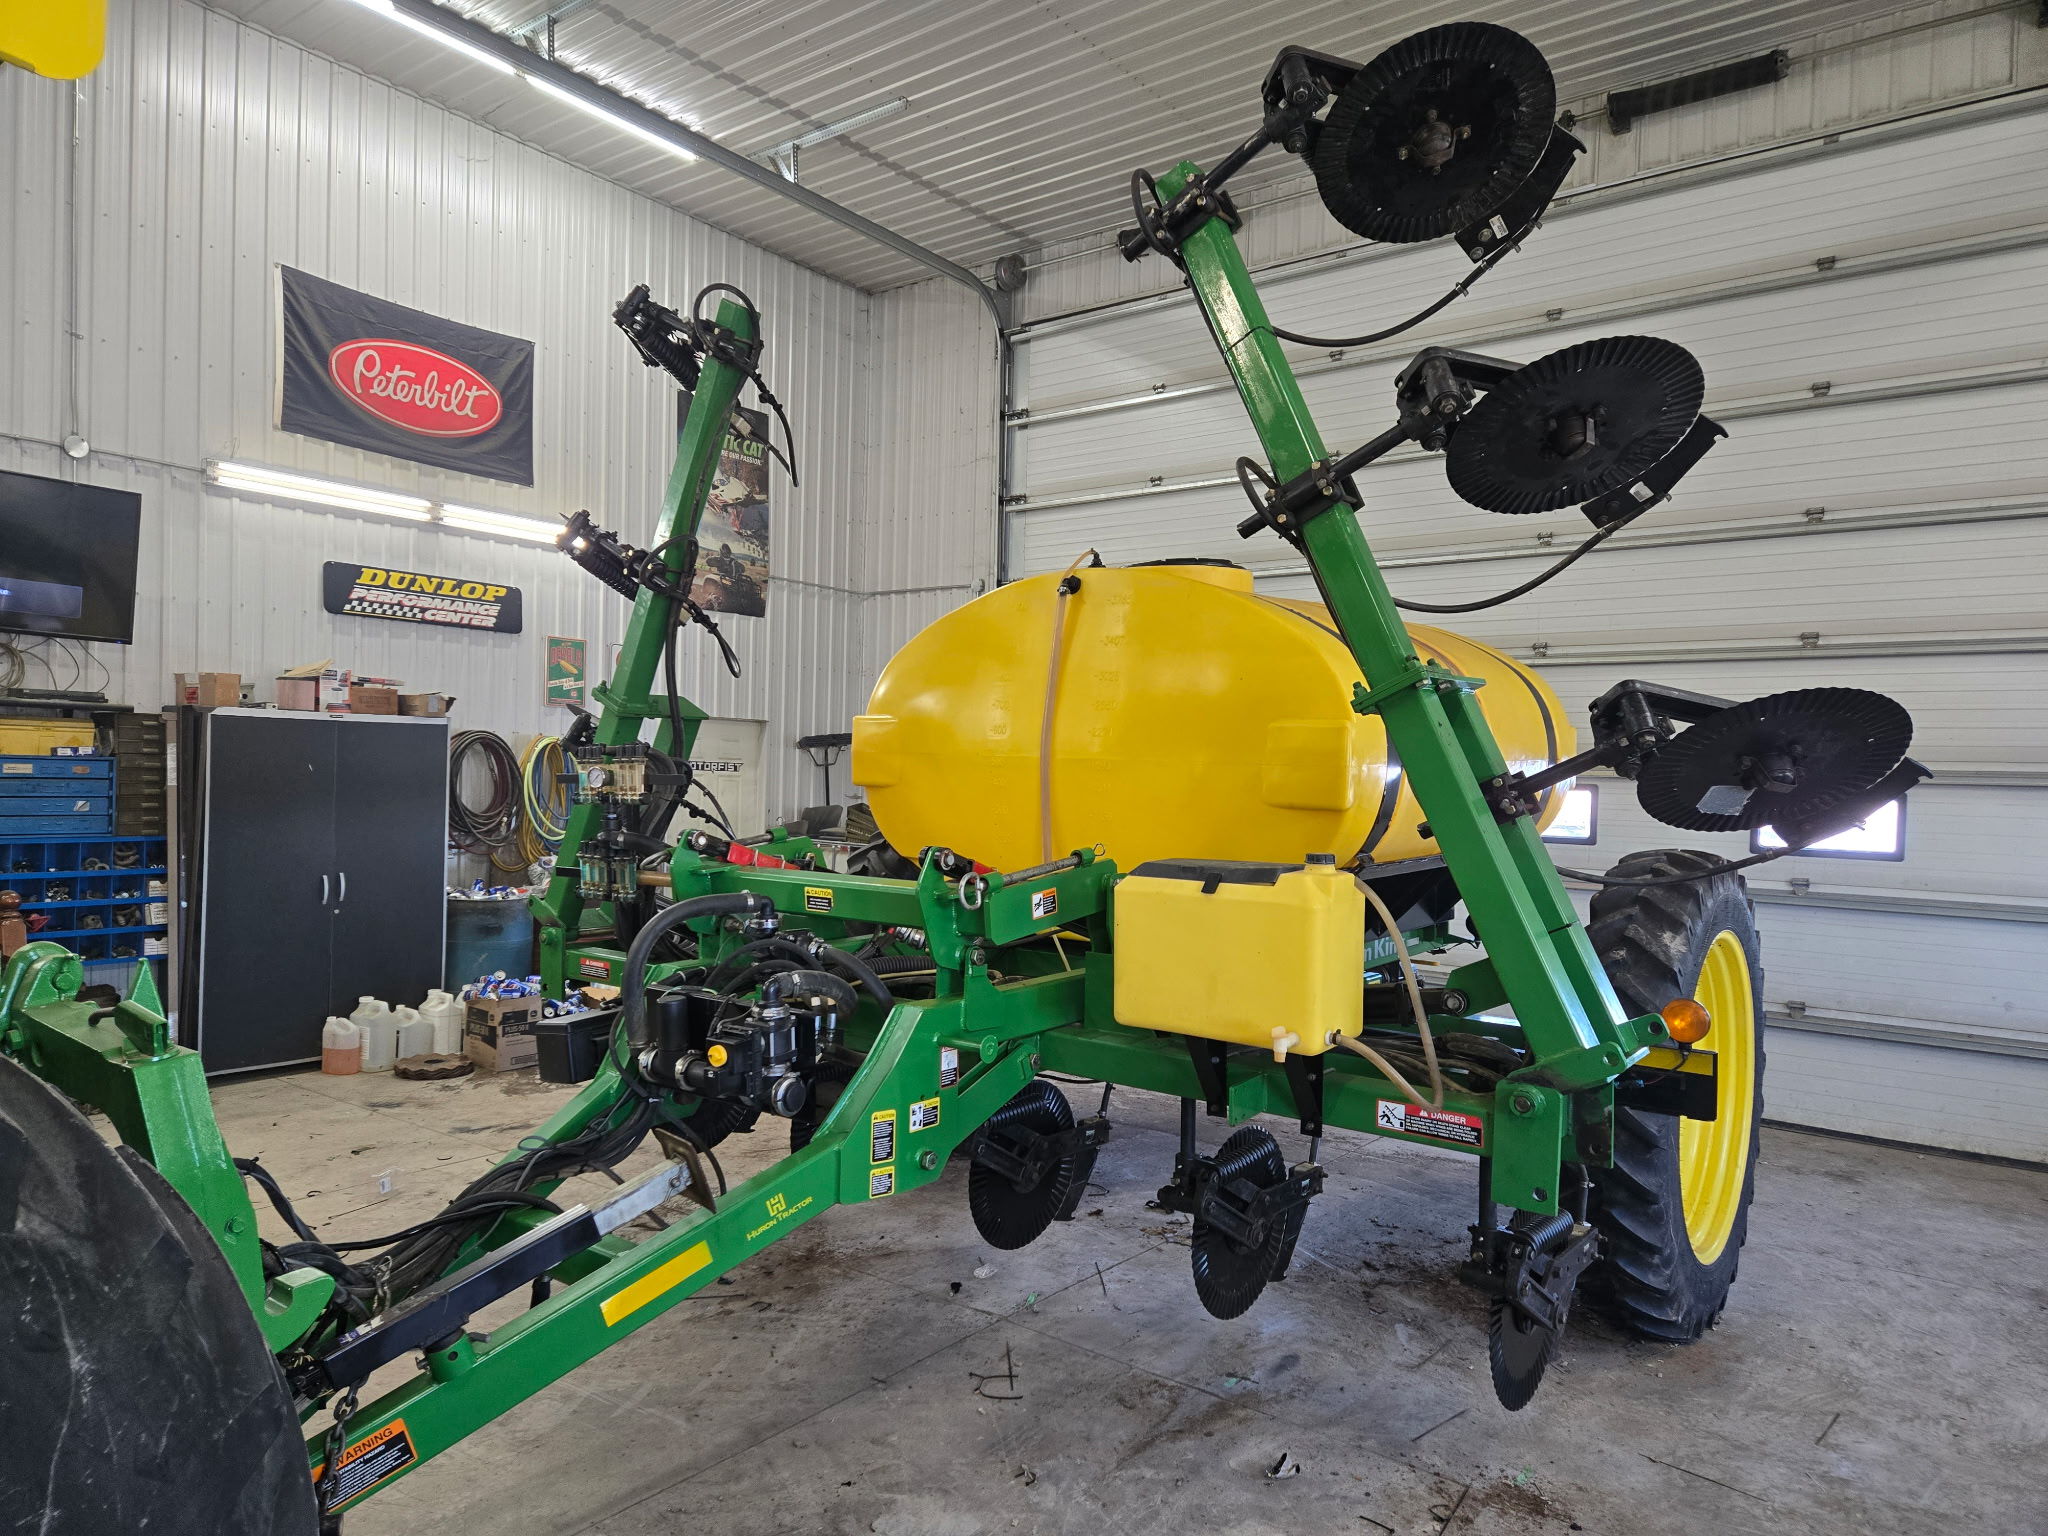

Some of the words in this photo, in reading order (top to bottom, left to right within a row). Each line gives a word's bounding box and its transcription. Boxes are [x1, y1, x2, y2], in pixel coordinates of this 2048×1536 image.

[353, 349, 489, 419] Peterbilt
[729, 452, 739, 460] OUR
[742, 440, 765, 457] CAT
[355, 567, 507, 601] DUNLOP
[348, 587, 501, 617] PERFORMANCE
[422, 609, 498, 628] CENTER
[688, 761, 743, 773] OTORFIST
[1374, 936, 1397, 959] Kin
[1431, 1112, 1466, 1125] DANGER
[746, 1218, 777, 1241] HURON
[776, 1196, 813, 1221] TRACTOR
